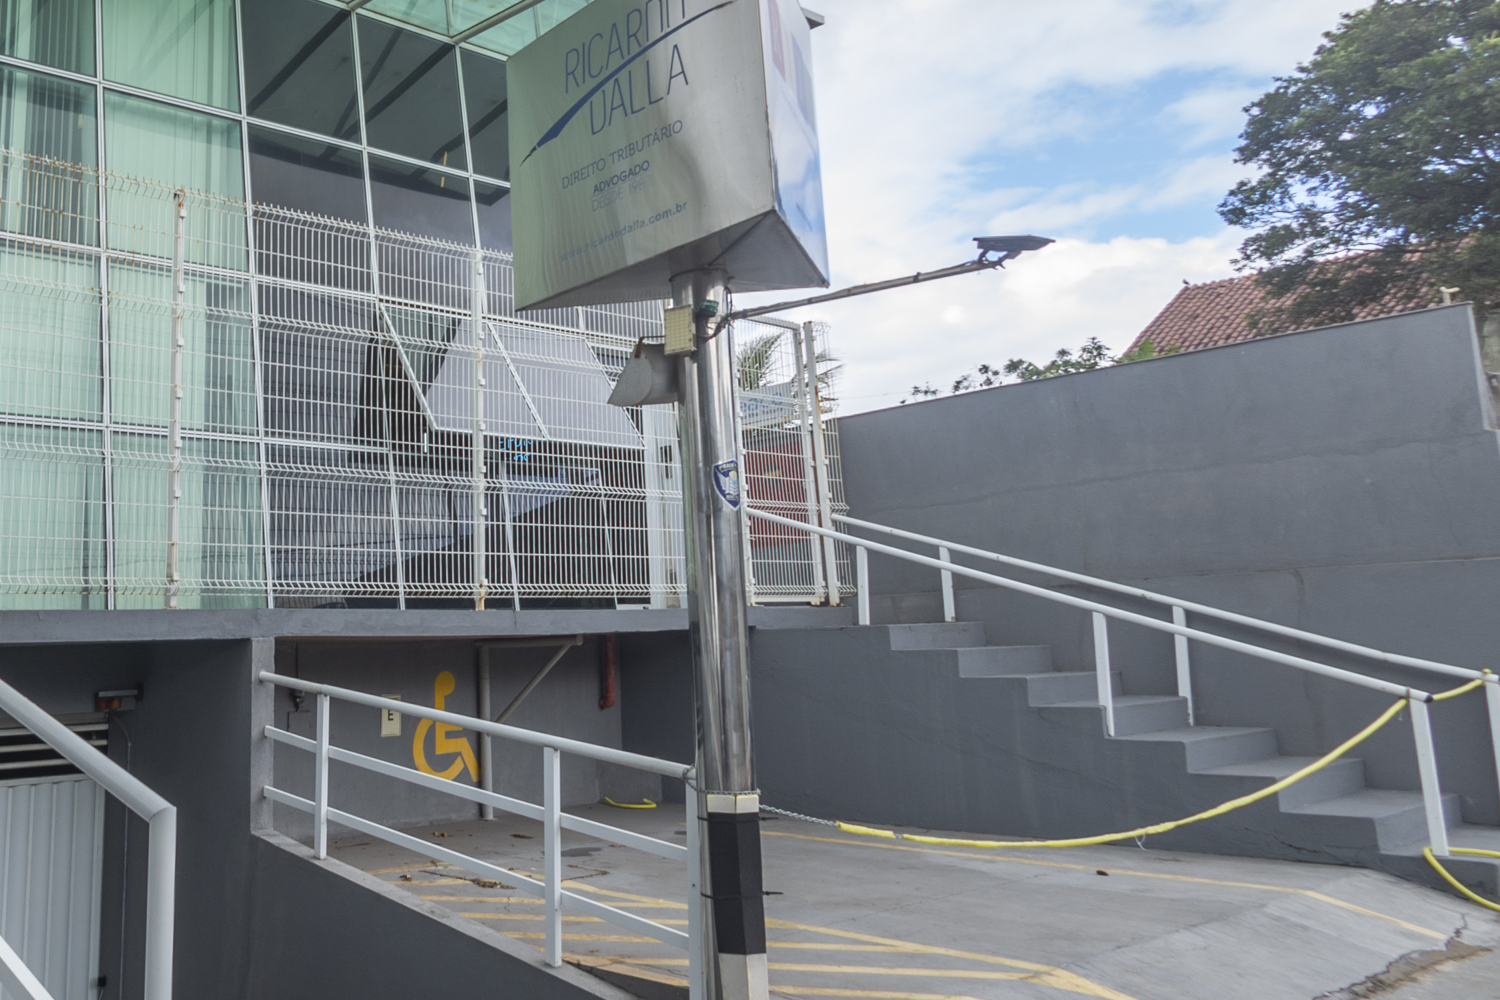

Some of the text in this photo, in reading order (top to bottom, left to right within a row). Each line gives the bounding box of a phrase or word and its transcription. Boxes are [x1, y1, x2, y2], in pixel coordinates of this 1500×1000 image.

[588, 44, 689, 136] DALLA
[561, 119, 683, 189] DIREITO TRIBUTÁRIO
[593, 160, 650, 195] ADVOGADO
[591, 187, 624, 212] DESDE
